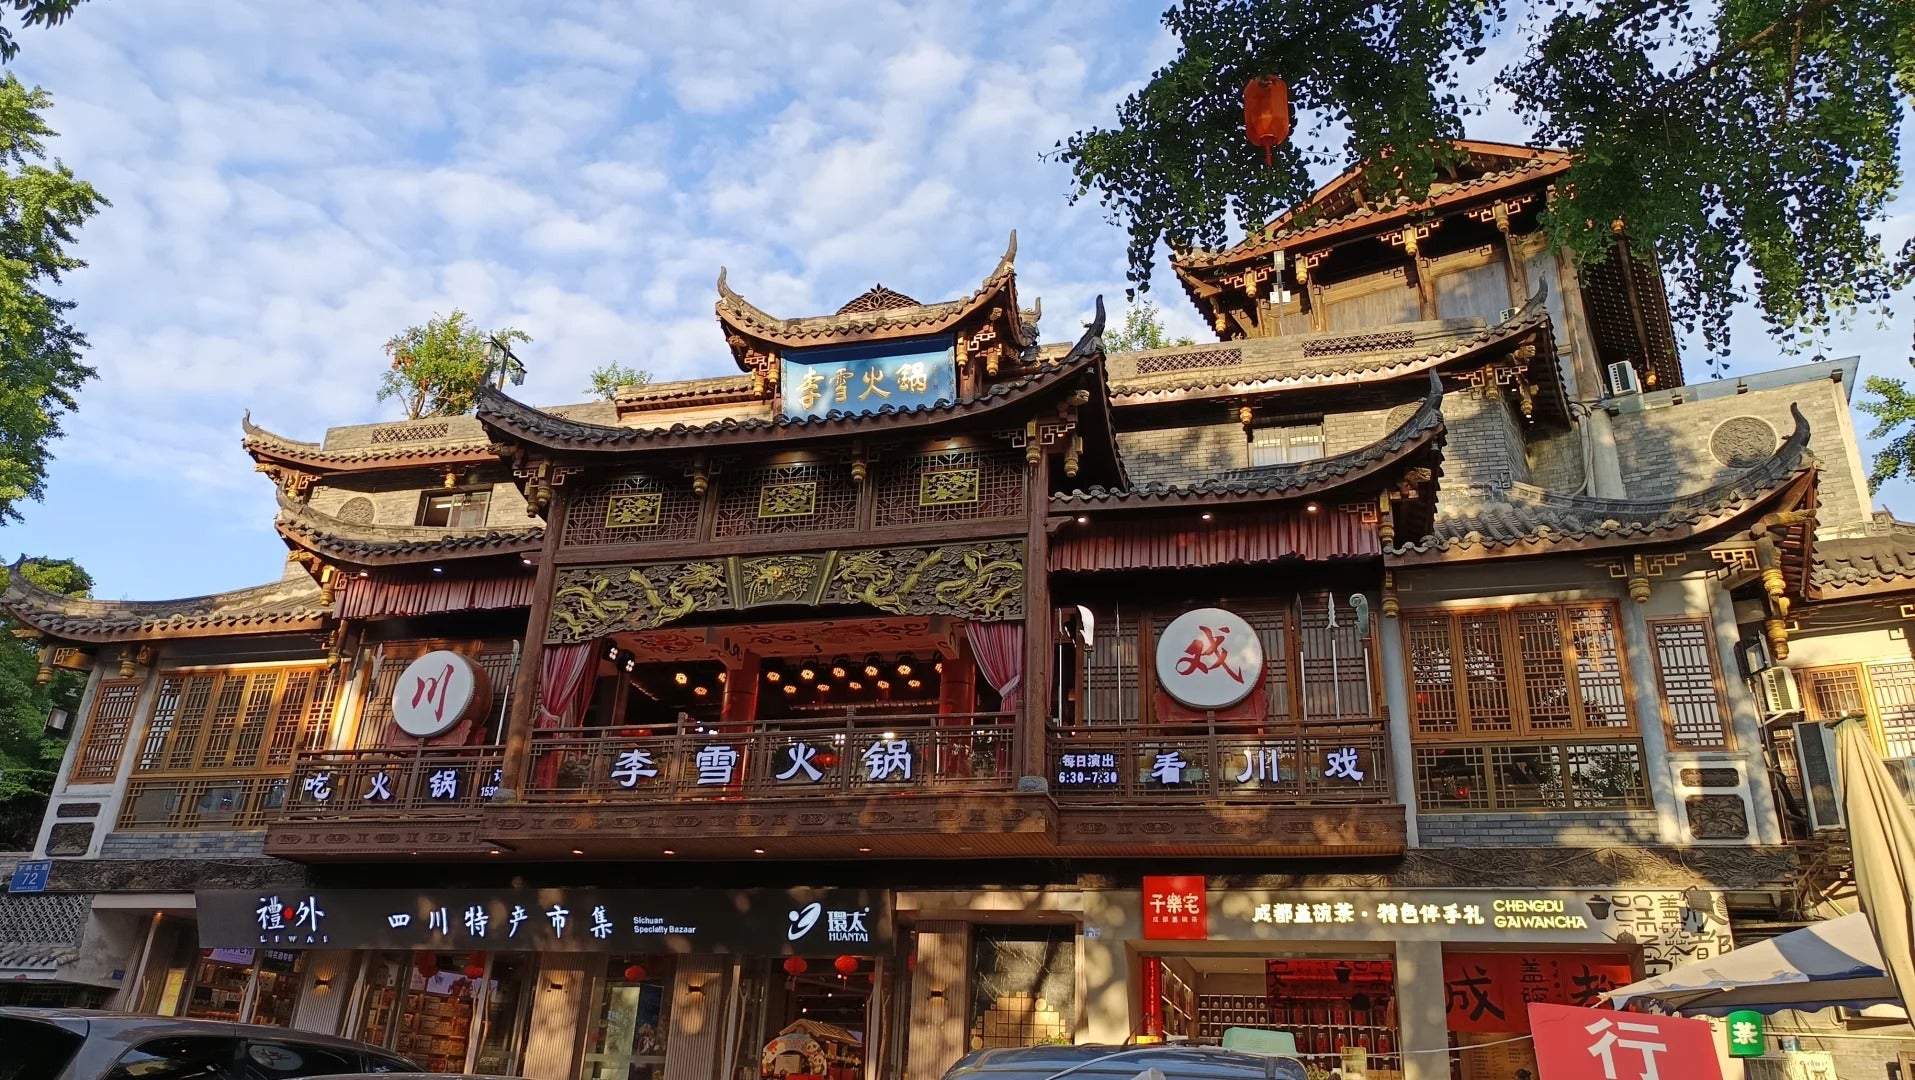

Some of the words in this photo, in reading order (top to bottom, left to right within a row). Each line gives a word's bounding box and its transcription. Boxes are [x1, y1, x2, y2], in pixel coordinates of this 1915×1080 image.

[1175, 625, 1245, 685] 戏
[411, 663, 455, 723] 川
[610, 739, 912, 788] 李雪火锅
[1061, 753, 1115, 768] 每日演出
[1150, 747, 1364, 785] 看川戏
[304, 769, 457, 800] 吃火锅
[22, 872, 38, 885] 72
[1493, 899, 1564, 913] CHENGDU
[386, 904, 613, 939] 四川特产市集
[633, 916, 664, 925] Sichuan
[1493, 914, 1588, 929] GAIWANCHA
[633, 925, 669, 935] Specialty
[669, 925, 696, 934] Bazaar
[829, 932, 869, 942] HUANTAI
